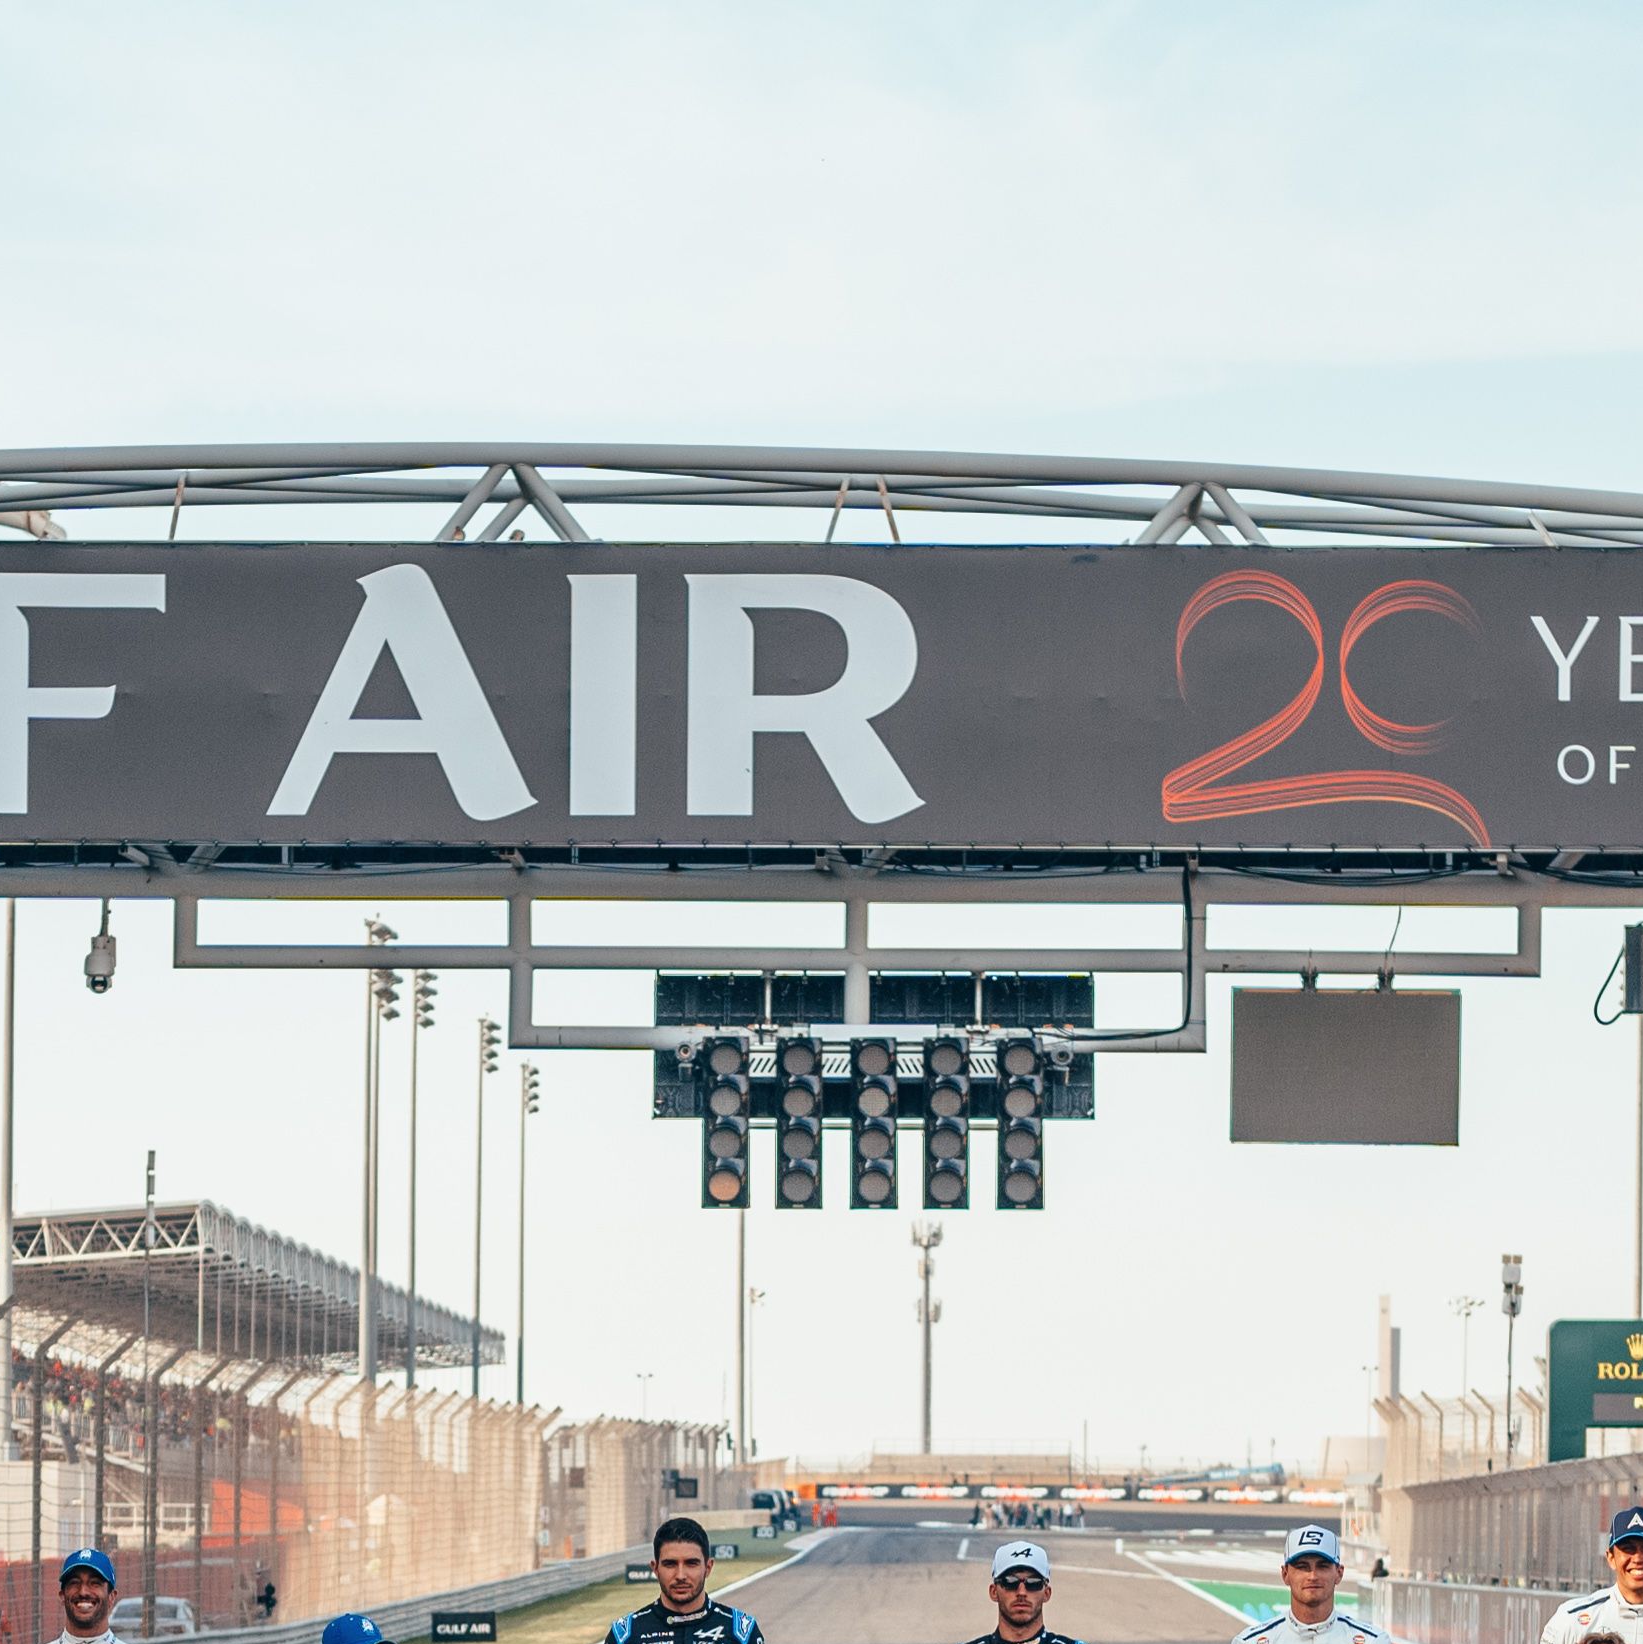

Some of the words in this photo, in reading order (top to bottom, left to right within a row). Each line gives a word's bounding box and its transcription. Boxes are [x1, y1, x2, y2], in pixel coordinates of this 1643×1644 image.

[266, 563, 927, 824] AIR
[1556, 745, 1636, 786] OF
[757, 1526, 775, 1538] 100
[628, 1571, 650, 1579] GULF
[437, 1624, 468, 1634] GULF
[469, 1624, 491, 1634] AIR
[641, 1631, 674, 1639] ALPINE
